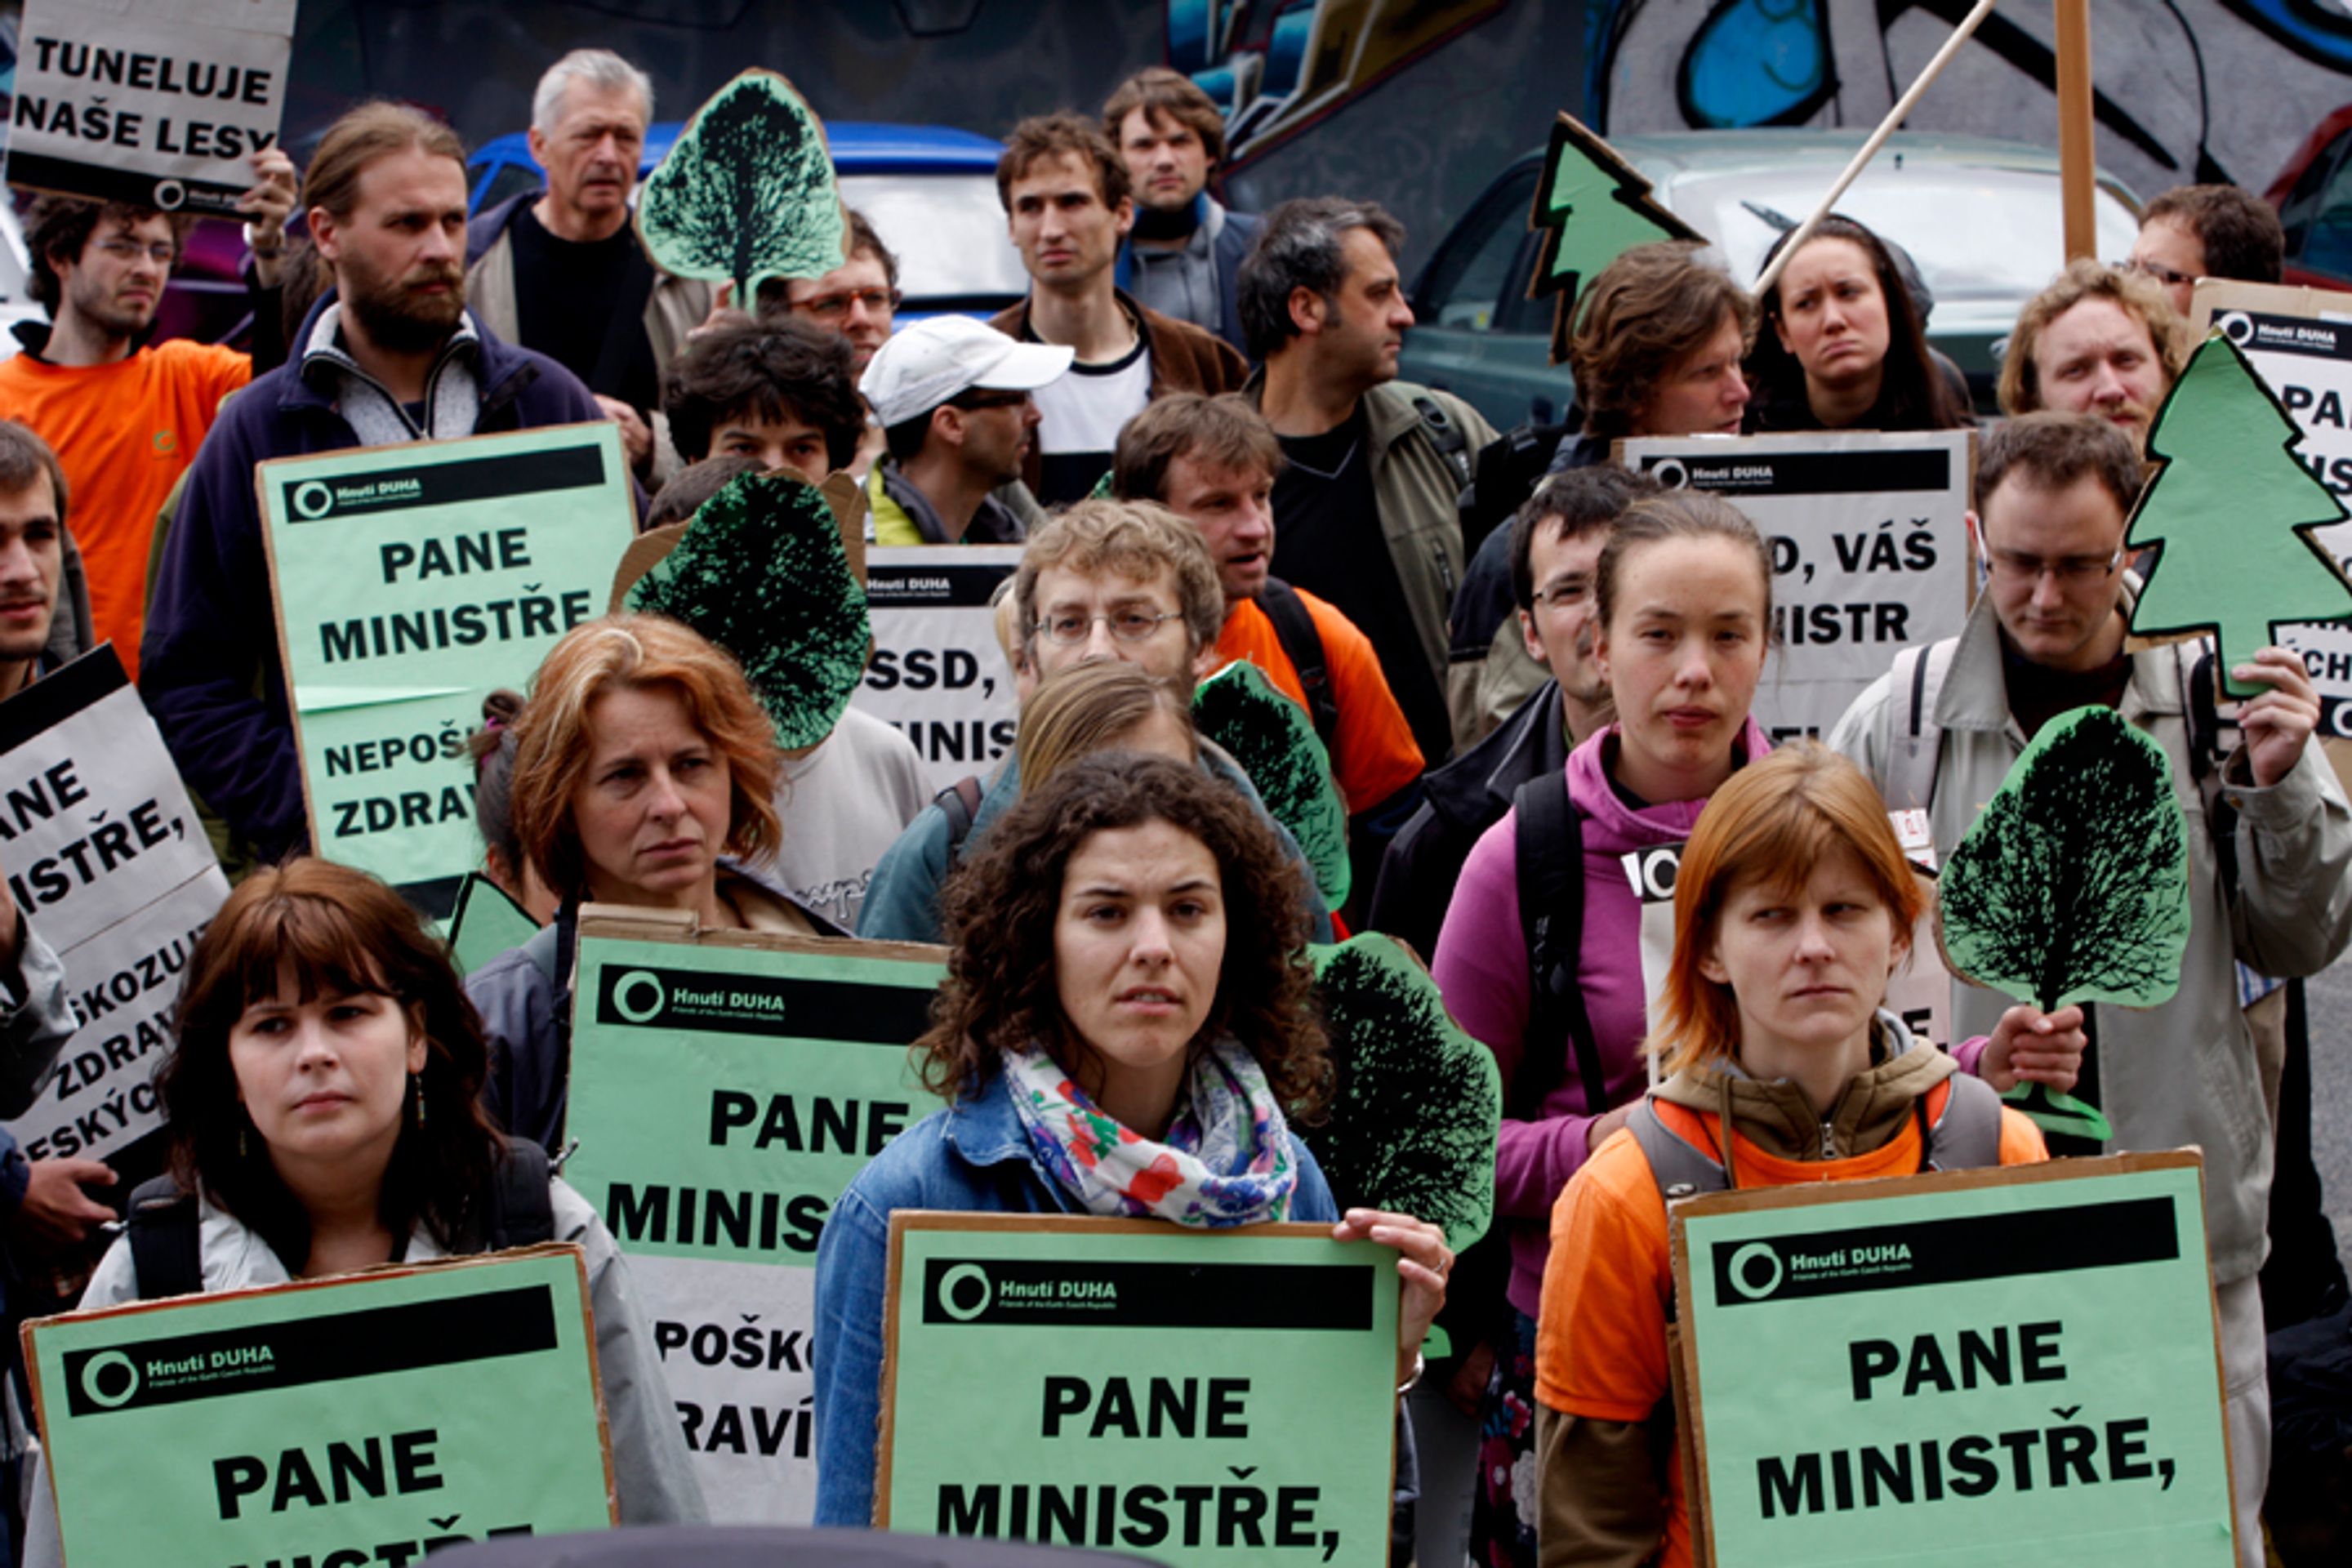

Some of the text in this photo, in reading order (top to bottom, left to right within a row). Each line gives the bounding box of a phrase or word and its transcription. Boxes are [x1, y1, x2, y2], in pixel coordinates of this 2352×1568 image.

[34, 37, 271, 105] TUNELUJE
[15, 95, 276, 159] NAŠE LESY
[2296, 327, 2336, 344] DUHA
[2282, 384, 2352, 430] PA
[378, 478, 422, 494] DUHA
[1732, 466, 1773, 479] DUHA
[380, 527, 532, 585] PANE
[1832, 518, 1938, 572] VÁŠ
[908, 577, 951, 590] DUHA
[319, 582, 590, 663] MINISTŘE
[323, 718, 474, 777] NEPOŠ
[673, 987, 785, 1011] Hnutí DUHA
[709, 1089, 909, 1156] PANE
[606, 1181, 838, 1253] MINIS
[1789, 1243, 1913, 1271] Hnutí DUHA
[999, 1280, 1118, 1298] Hnutí DUHA
[145, 1345, 274, 1378] Hnutí DUHA
[655, 1312, 814, 1373] POŠK
[1848, 1320, 2068, 1402] PANE
[1040, 1375, 1251, 1439] PANE
[212, 1428, 444, 1521] PANE
[1757, 1405, 2176, 1520] MINISTŘE,
[936, 1465, 1340, 1562] MINISTŘE,
